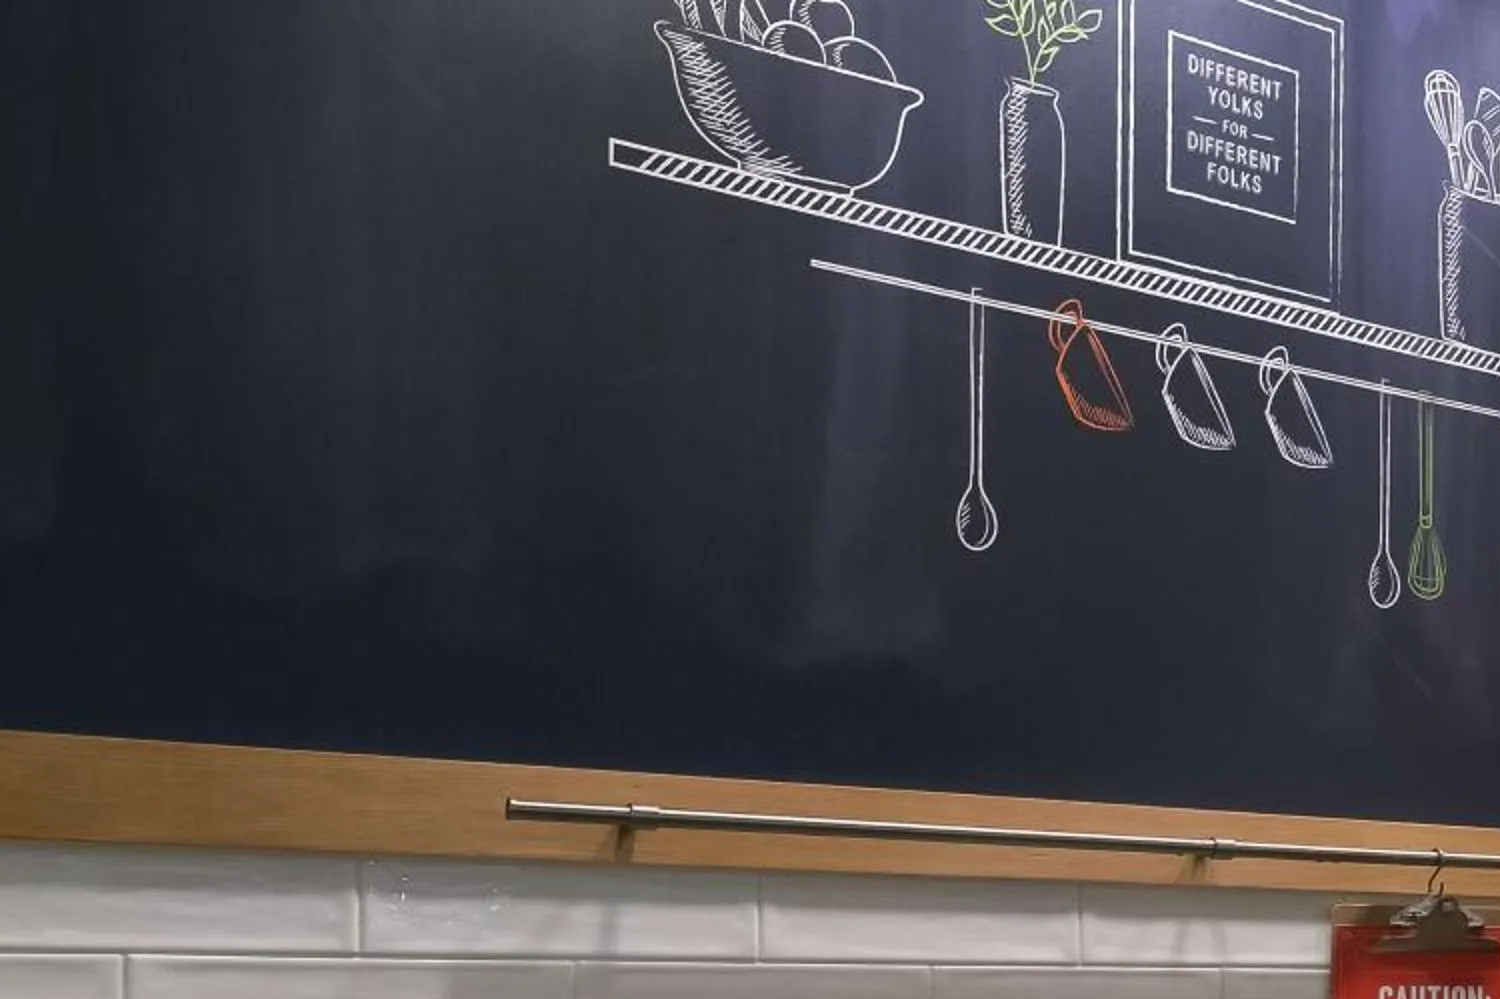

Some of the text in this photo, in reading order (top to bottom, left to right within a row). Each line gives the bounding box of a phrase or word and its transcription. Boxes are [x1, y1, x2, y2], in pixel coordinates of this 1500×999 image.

[1186, 53, 1283, 101] DIFFERENT
[1207, 85, 1264, 121] YOLKS
[1222, 119, 1249, 139] FOR
[1186, 130, 1283, 176] DIFFERENT
[1206, 161, 1263, 195] FOLKS
